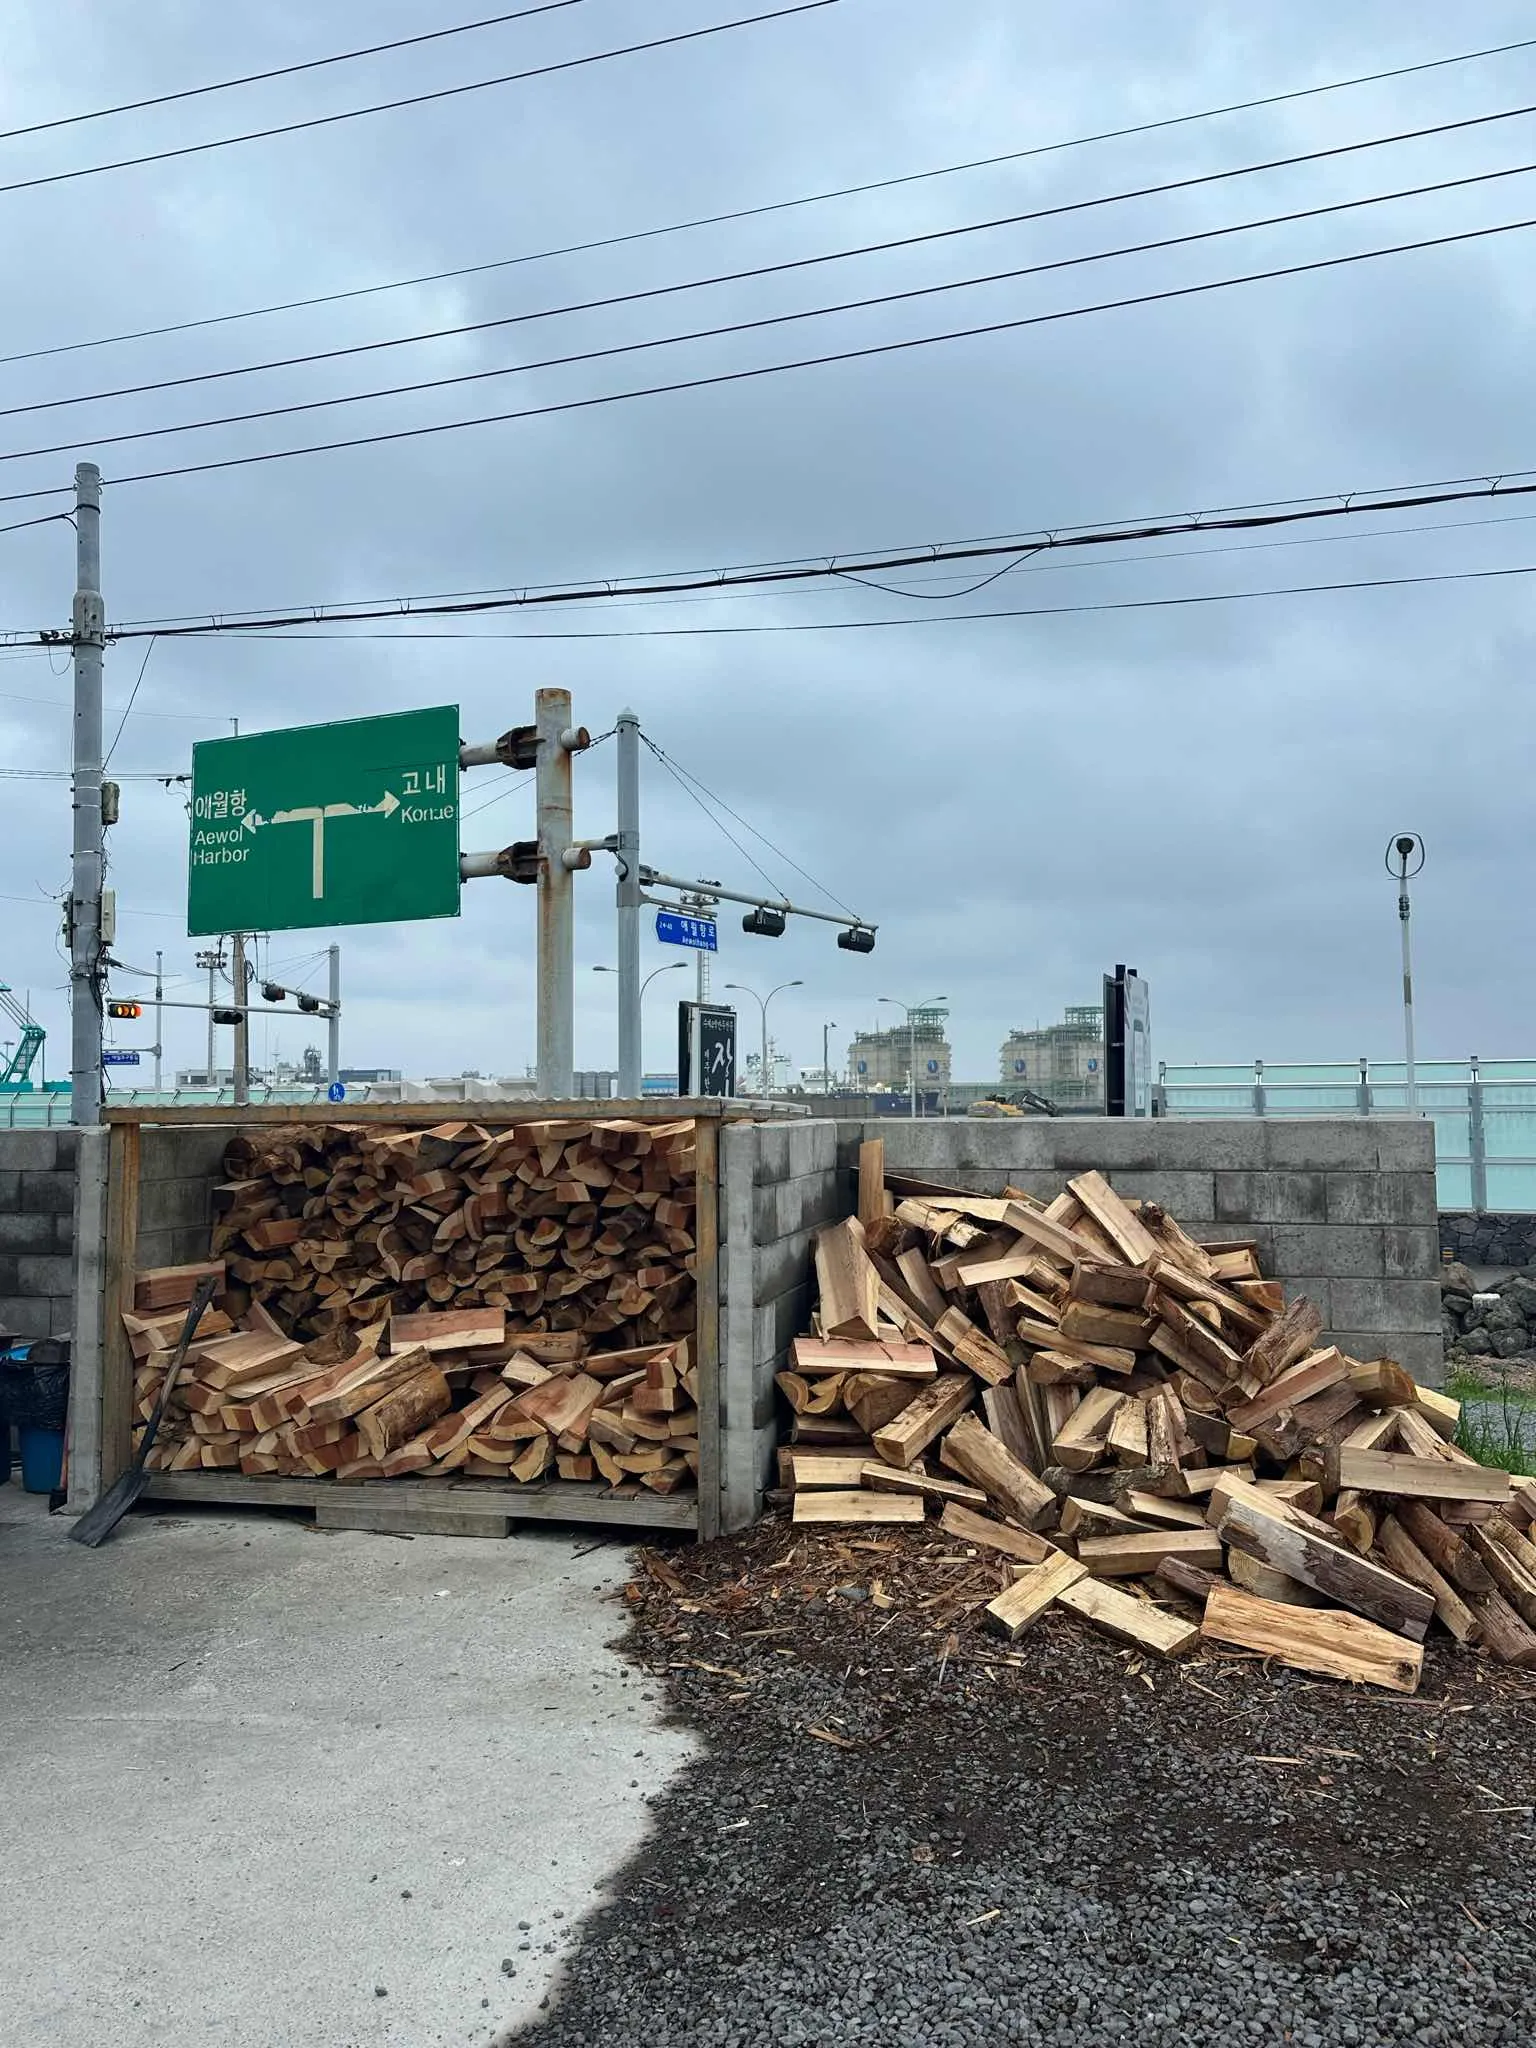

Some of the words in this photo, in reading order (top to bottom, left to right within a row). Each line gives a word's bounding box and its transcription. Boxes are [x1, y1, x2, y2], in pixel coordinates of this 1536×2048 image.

[401, 763, 446, 795] 고내
[195, 788, 247, 820] 애월항
[194, 824, 243, 846] Aewol
[193, 847, 250, 867] Harbor
